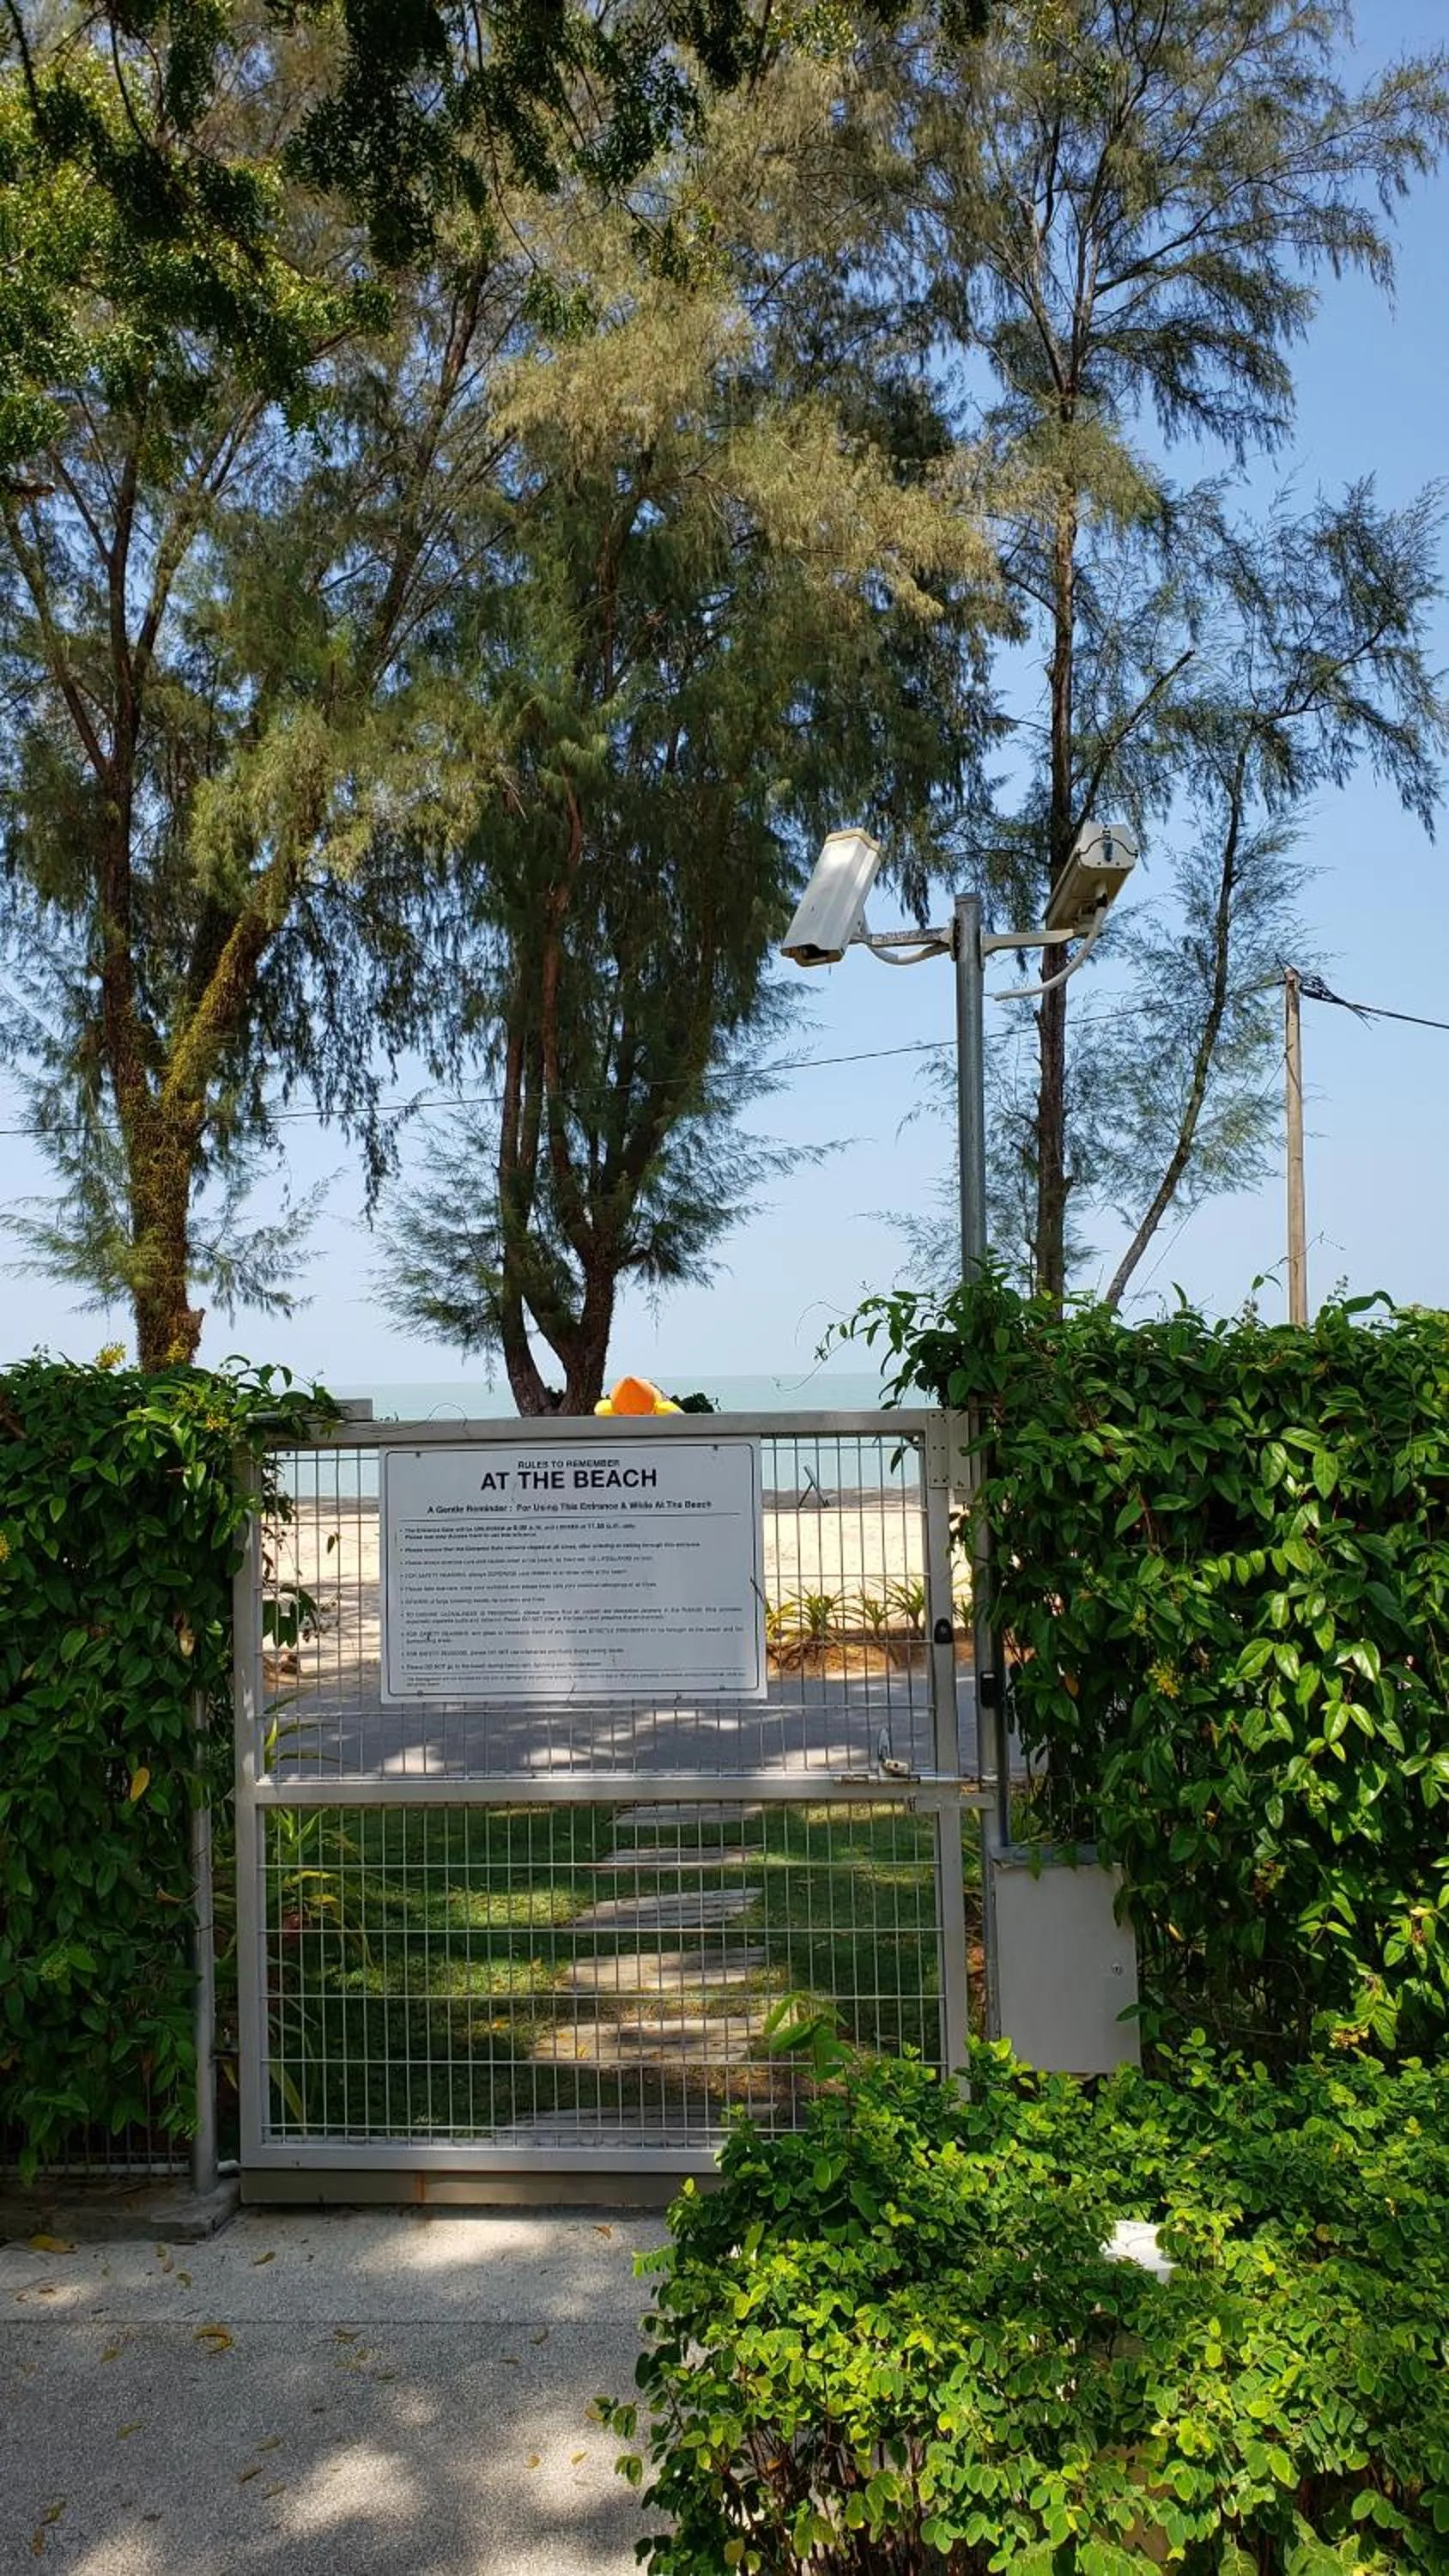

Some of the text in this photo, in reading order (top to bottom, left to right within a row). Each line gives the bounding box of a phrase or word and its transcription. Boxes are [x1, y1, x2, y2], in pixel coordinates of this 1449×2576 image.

[518, 1461, 549, 1469] RULES
[566, 1459, 621, 1467] REMEMBER
[481, 1468, 657, 1491] AT THE BEACH
[533, 1503, 558, 1513] Using
[561, 1502, 578, 1510] This
[580, 1502, 619, 1510] Entrance
[665, 1500, 682, 1509] The
[684, 1500, 712, 1509] Beach
